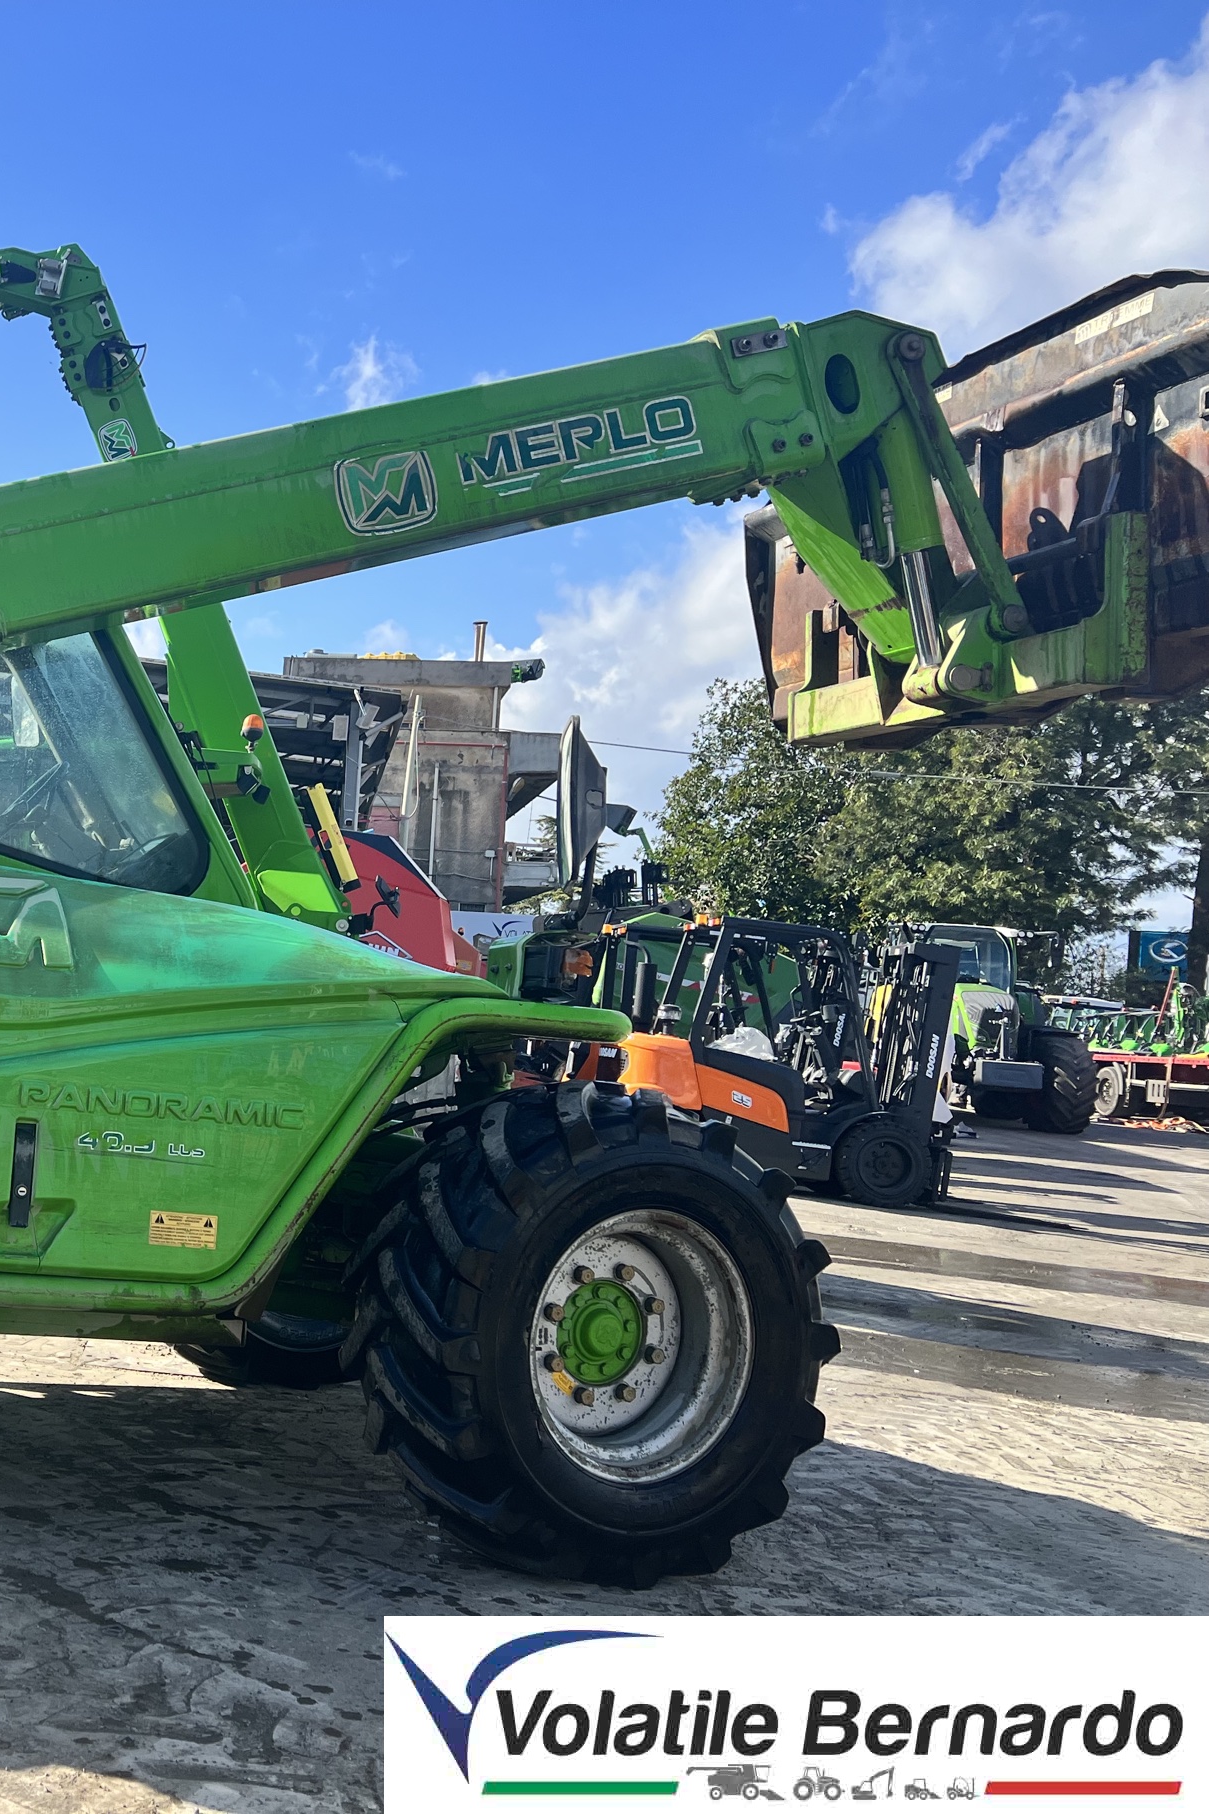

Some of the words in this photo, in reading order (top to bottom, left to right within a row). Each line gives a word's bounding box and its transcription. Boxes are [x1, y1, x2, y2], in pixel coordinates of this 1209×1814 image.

[456, 396, 697, 484] MERLO
[926, 1034, 940, 1078] DOOSAN
[19, 1080, 305, 1130] PANORAMIC
